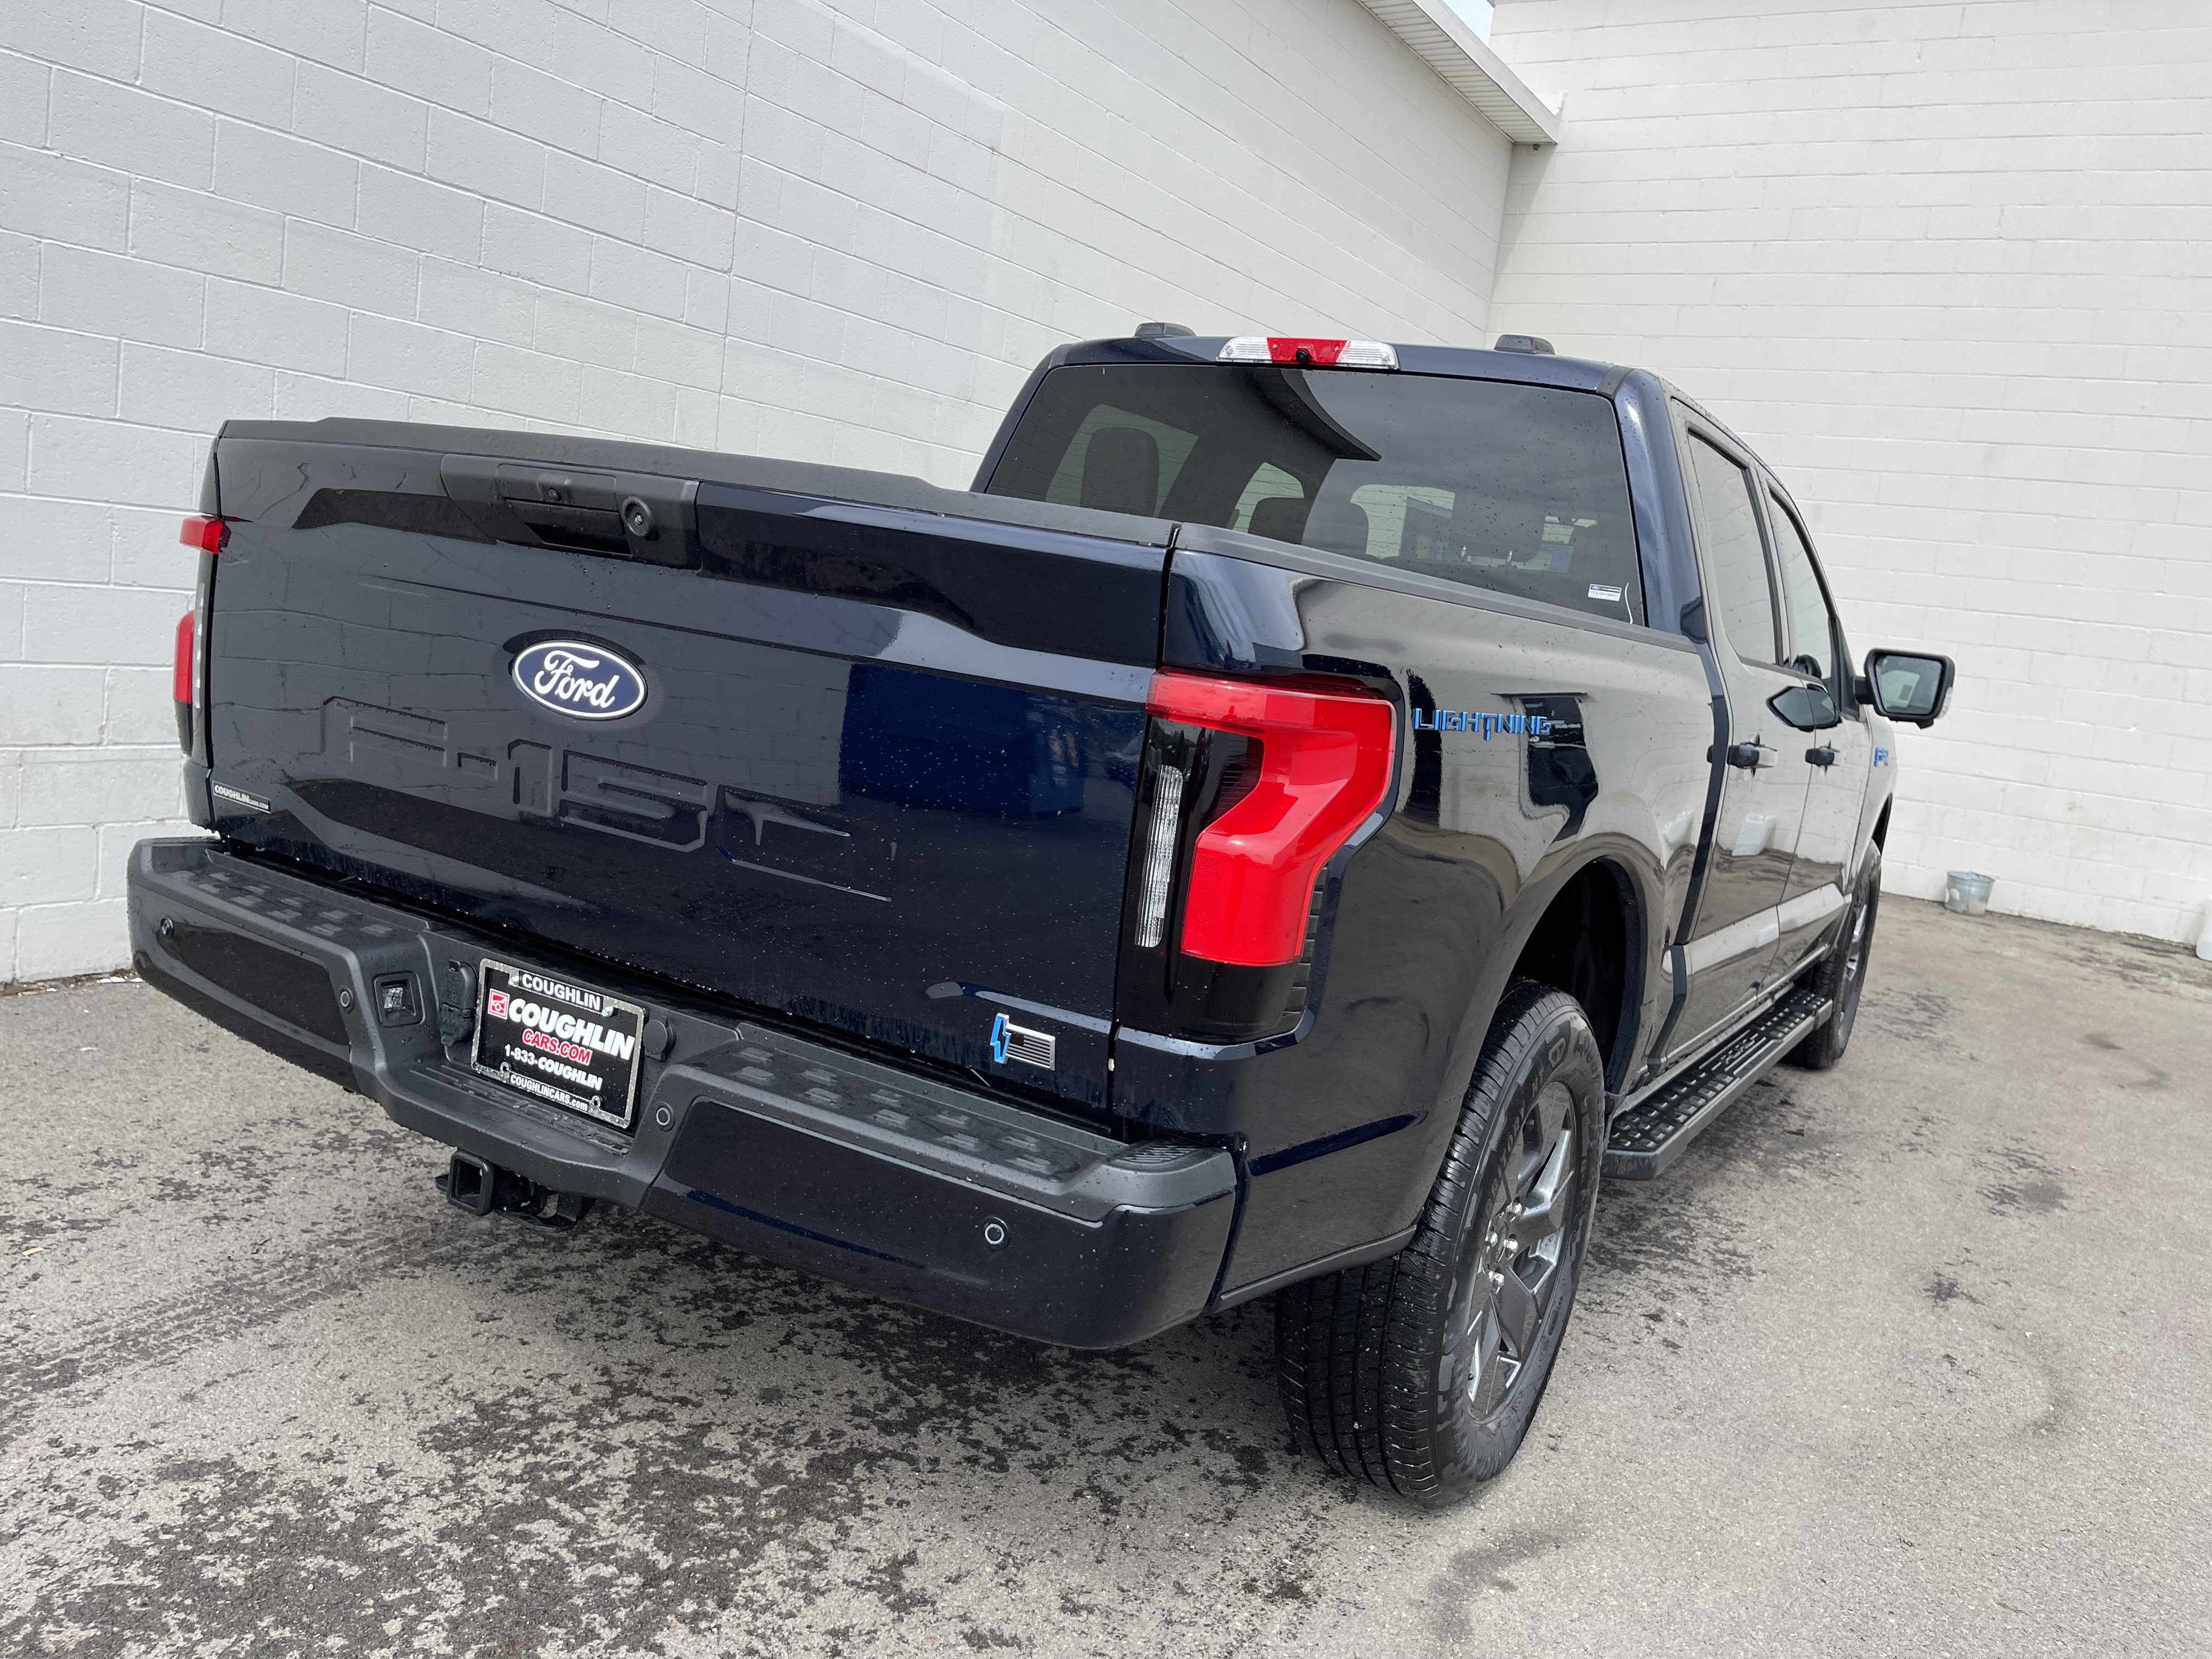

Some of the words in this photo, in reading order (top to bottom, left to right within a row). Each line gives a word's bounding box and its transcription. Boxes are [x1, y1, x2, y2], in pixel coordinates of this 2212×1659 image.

[534, 650, 620, 708] Ford
[1413, 707, 1551, 741] LIGHTNING
[522, 973, 601, 1011] COUGHLIN
[509, 998, 635, 1060] COUGHLIN
[522, 1028, 593, 1066] CARS.COM
[504, 1043, 603, 1091] 1-833-COUGHLIN
[510, 1074, 589, 1112] COUGHLINCARS.com
